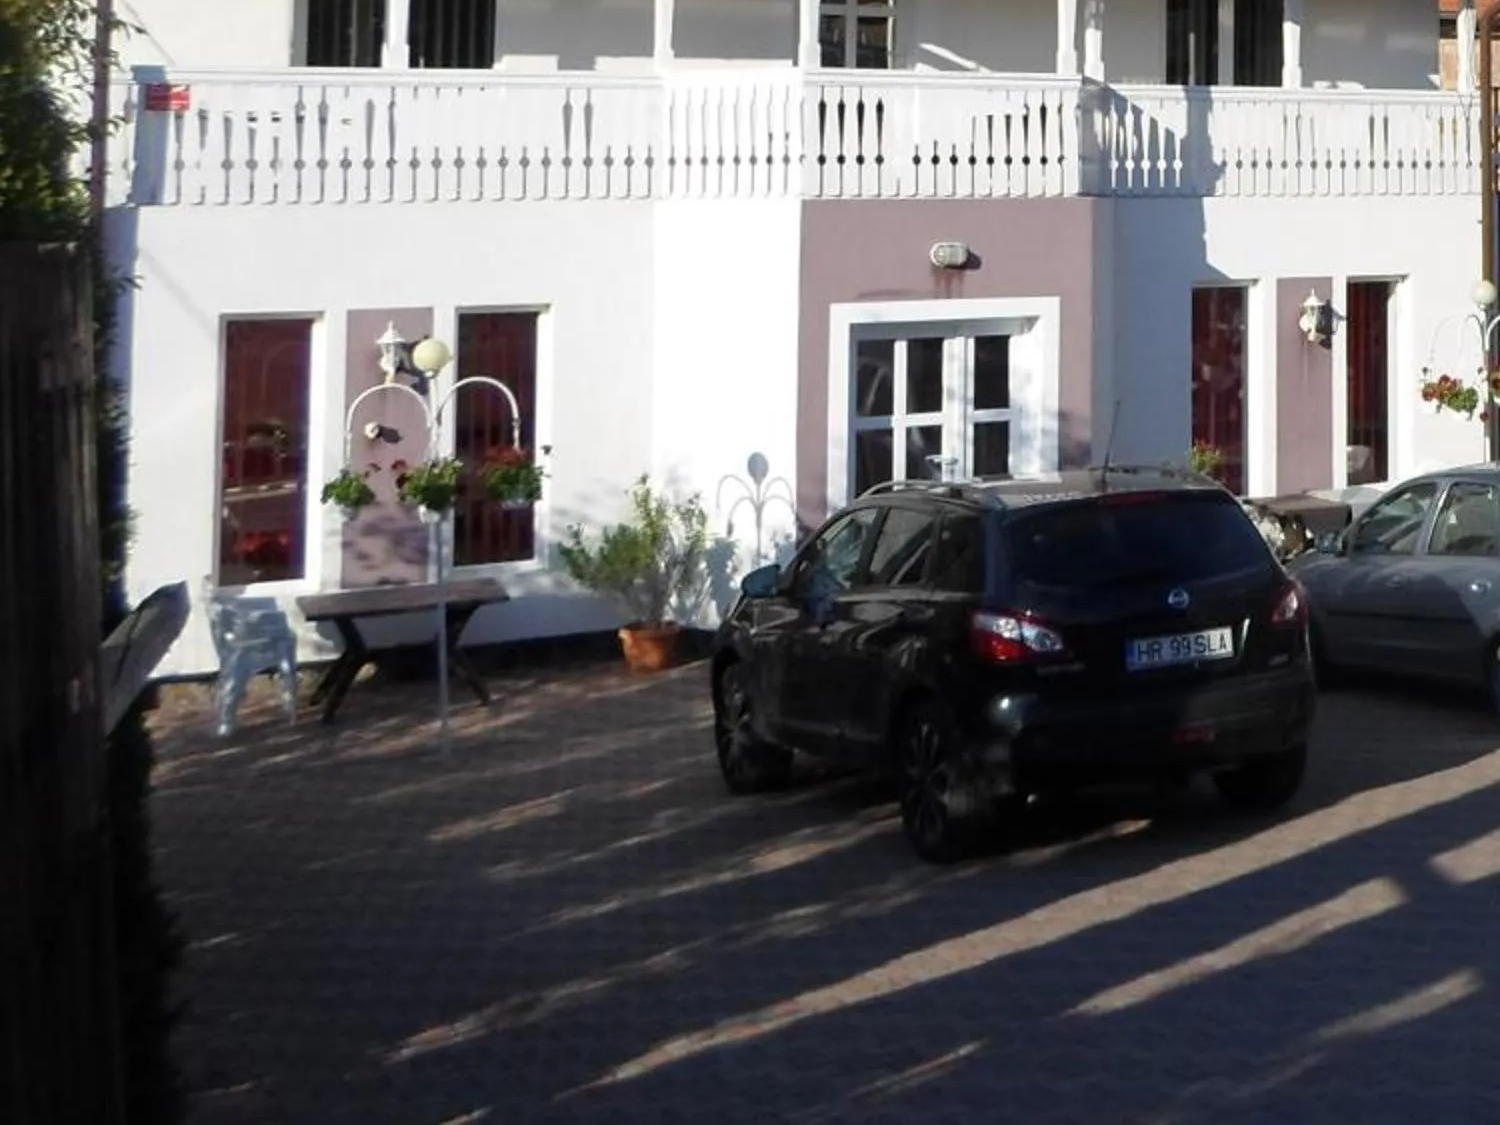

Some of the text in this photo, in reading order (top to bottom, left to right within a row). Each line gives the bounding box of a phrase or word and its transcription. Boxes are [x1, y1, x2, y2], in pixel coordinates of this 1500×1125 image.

[1137, 632, 1227, 663] HR 99 SLA
